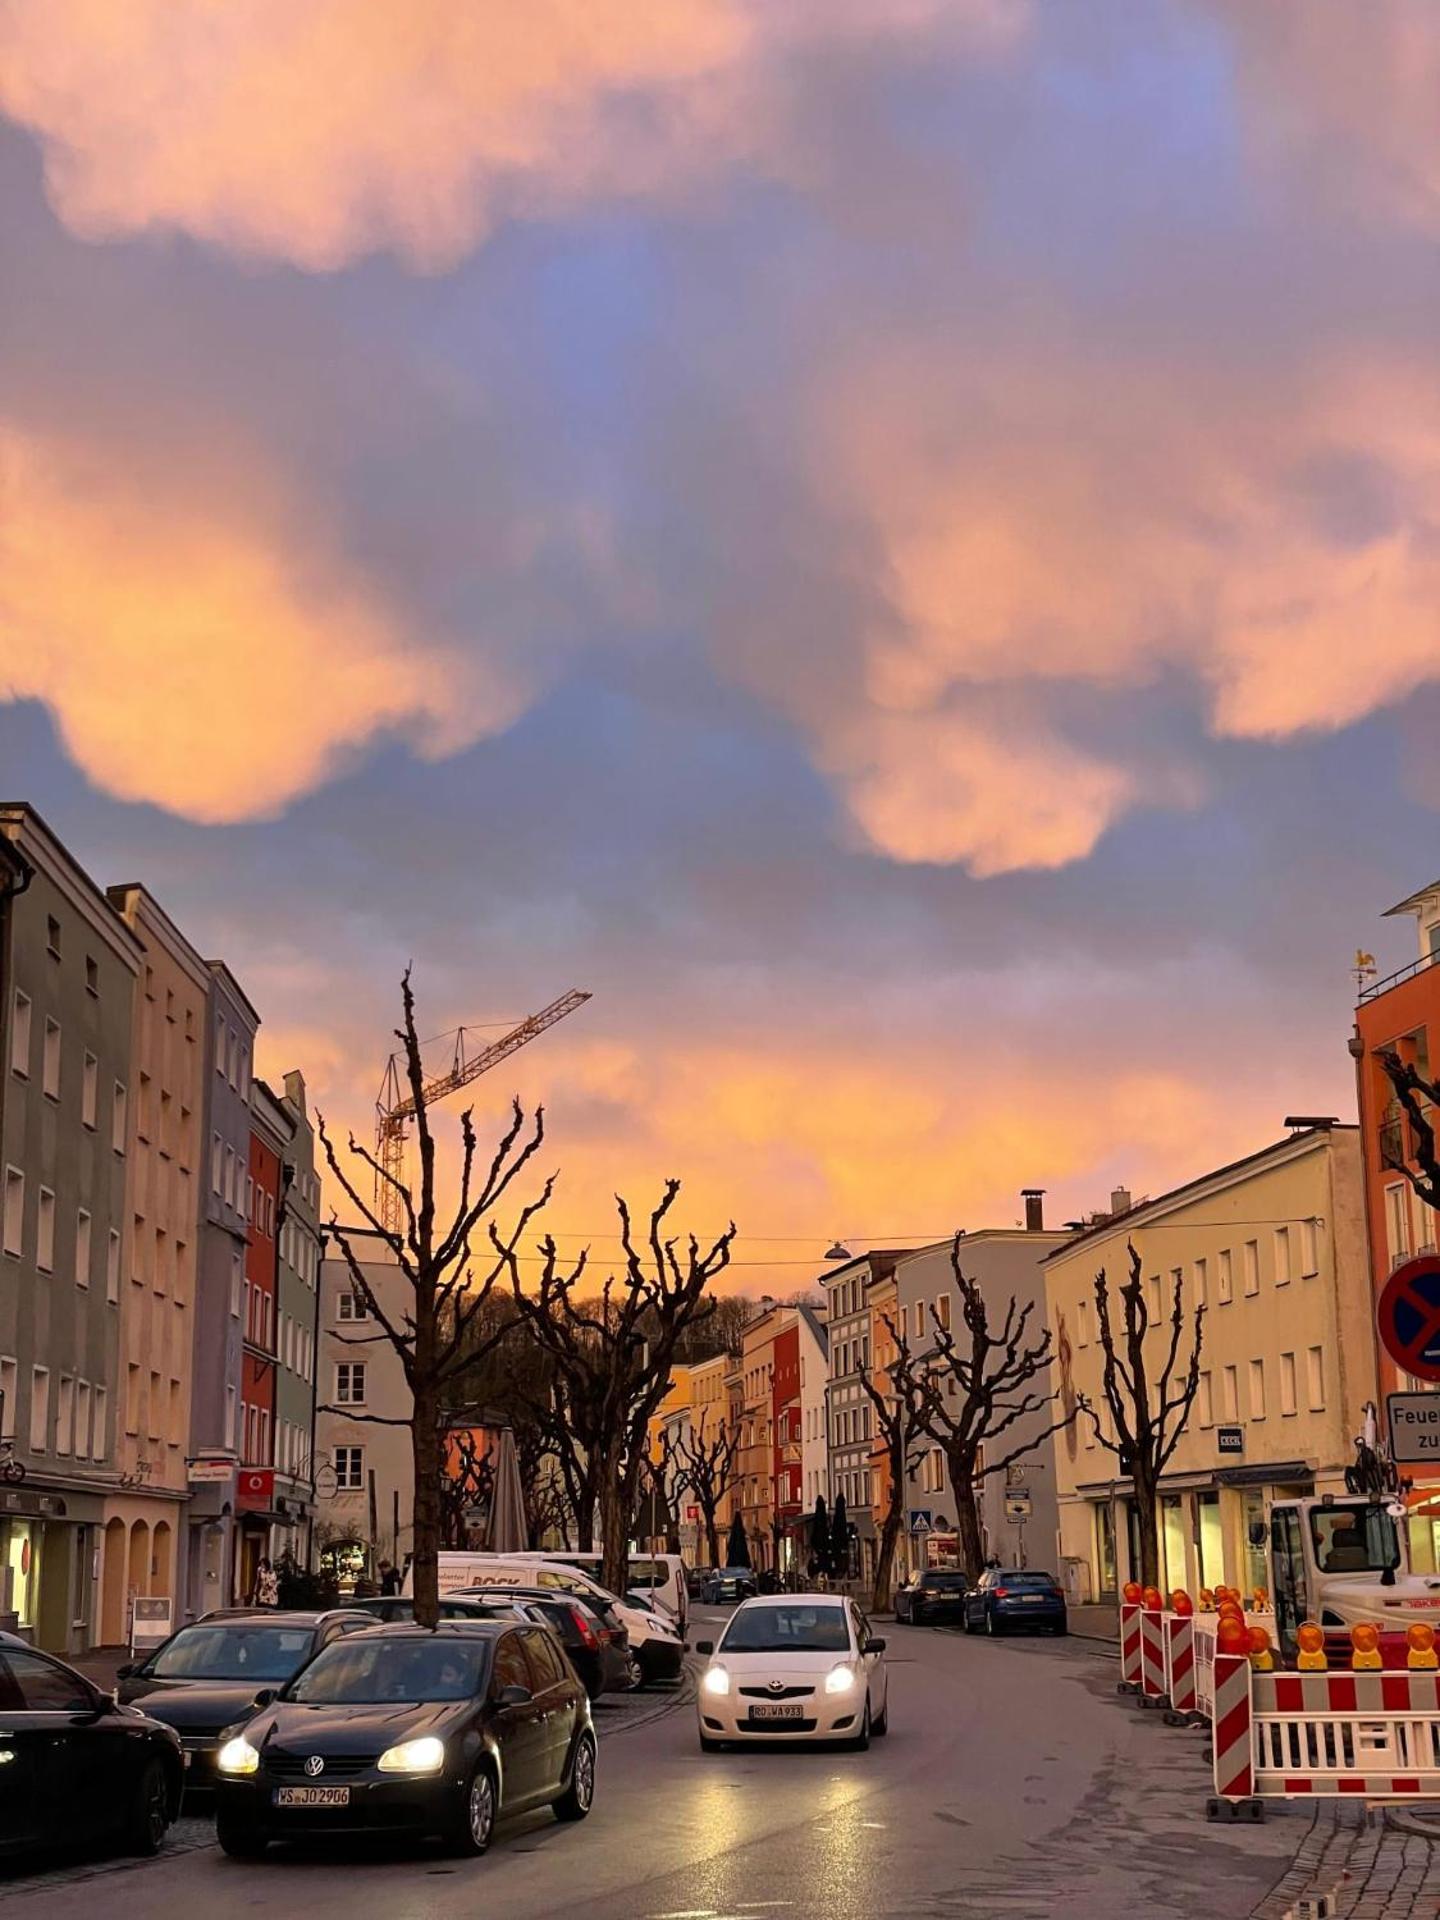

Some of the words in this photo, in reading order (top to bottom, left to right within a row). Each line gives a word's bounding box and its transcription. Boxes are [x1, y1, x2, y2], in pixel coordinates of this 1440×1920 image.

[1393, 1408, 1440, 1424] Feue
[1418, 1435, 1439, 1448] zu
[318, 1789, 348, 1803] 2906
